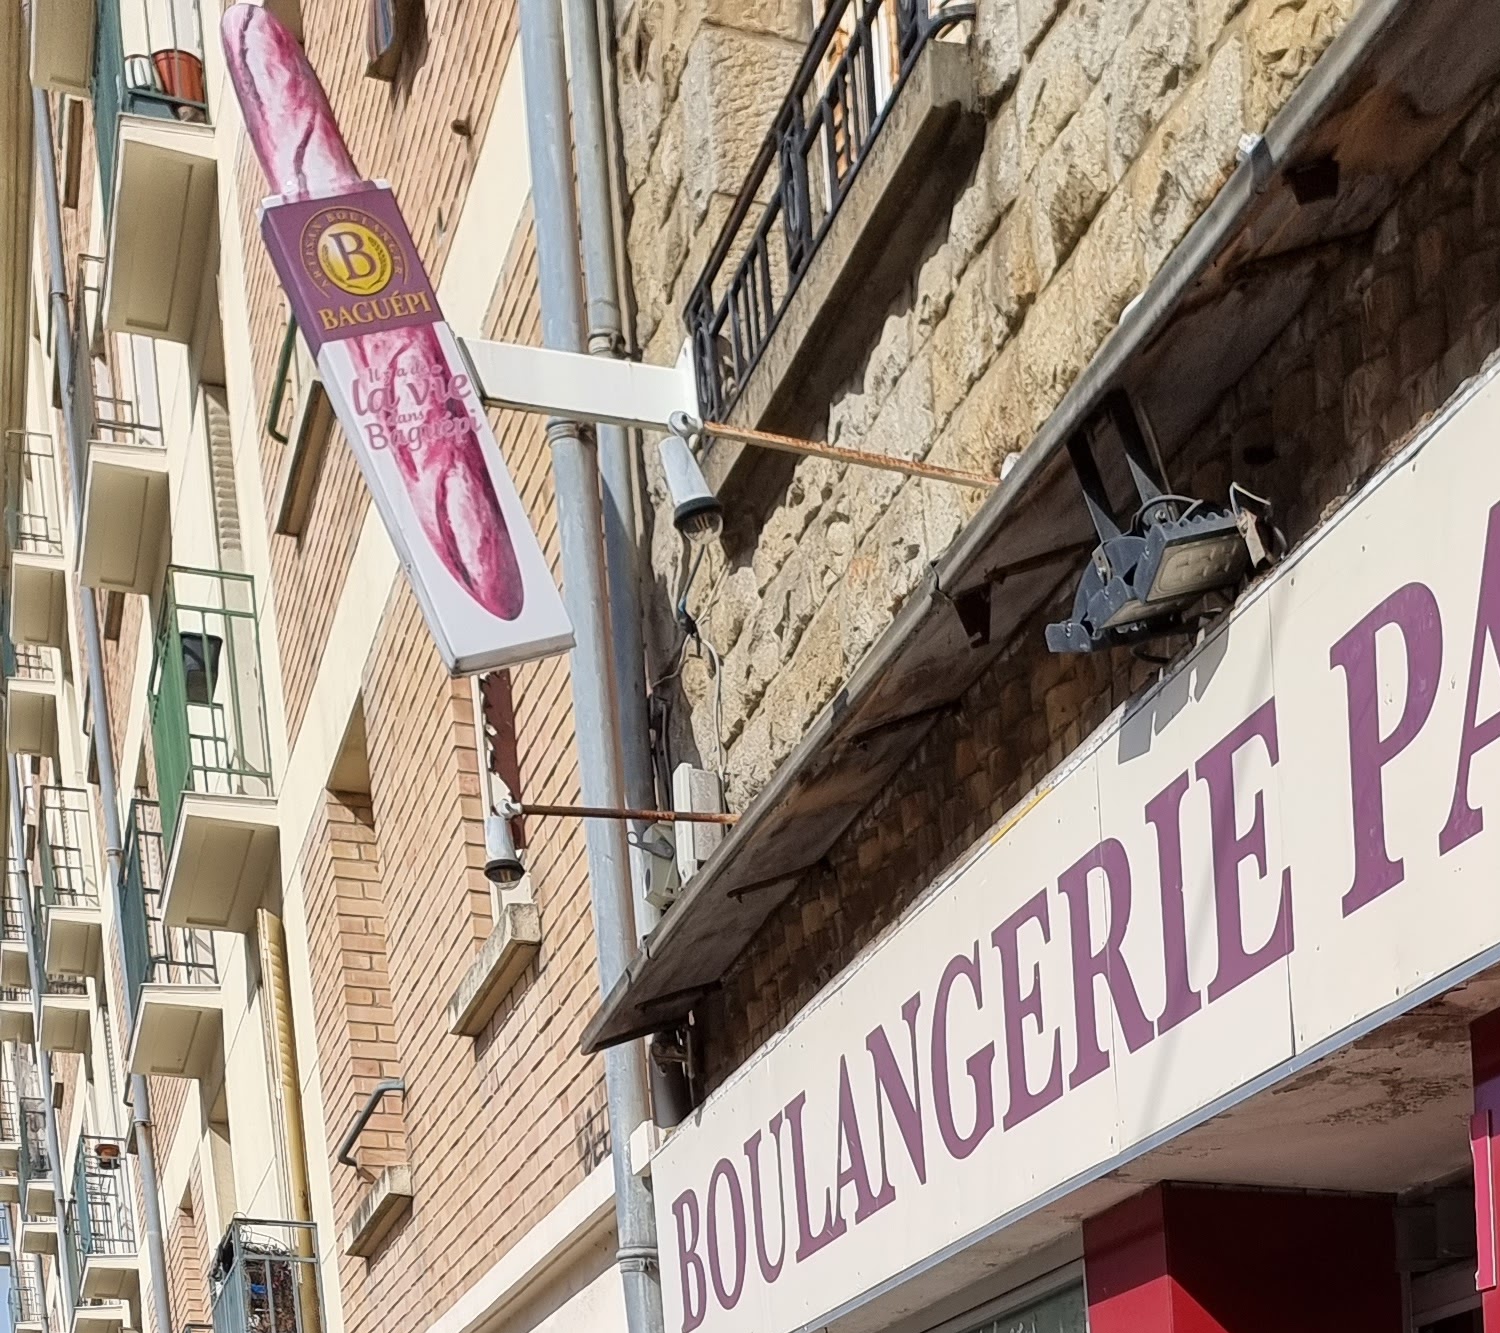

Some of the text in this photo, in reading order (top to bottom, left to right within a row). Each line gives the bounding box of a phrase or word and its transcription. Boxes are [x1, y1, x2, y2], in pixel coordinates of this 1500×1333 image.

[328, 231, 377, 280] B
[318, 290, 432, 331] BAGUÉPI
[352, 364, 472, 416] la vie
[363, 408, 482, 451] Baguépi
[386, 408, 424, 426] dans
